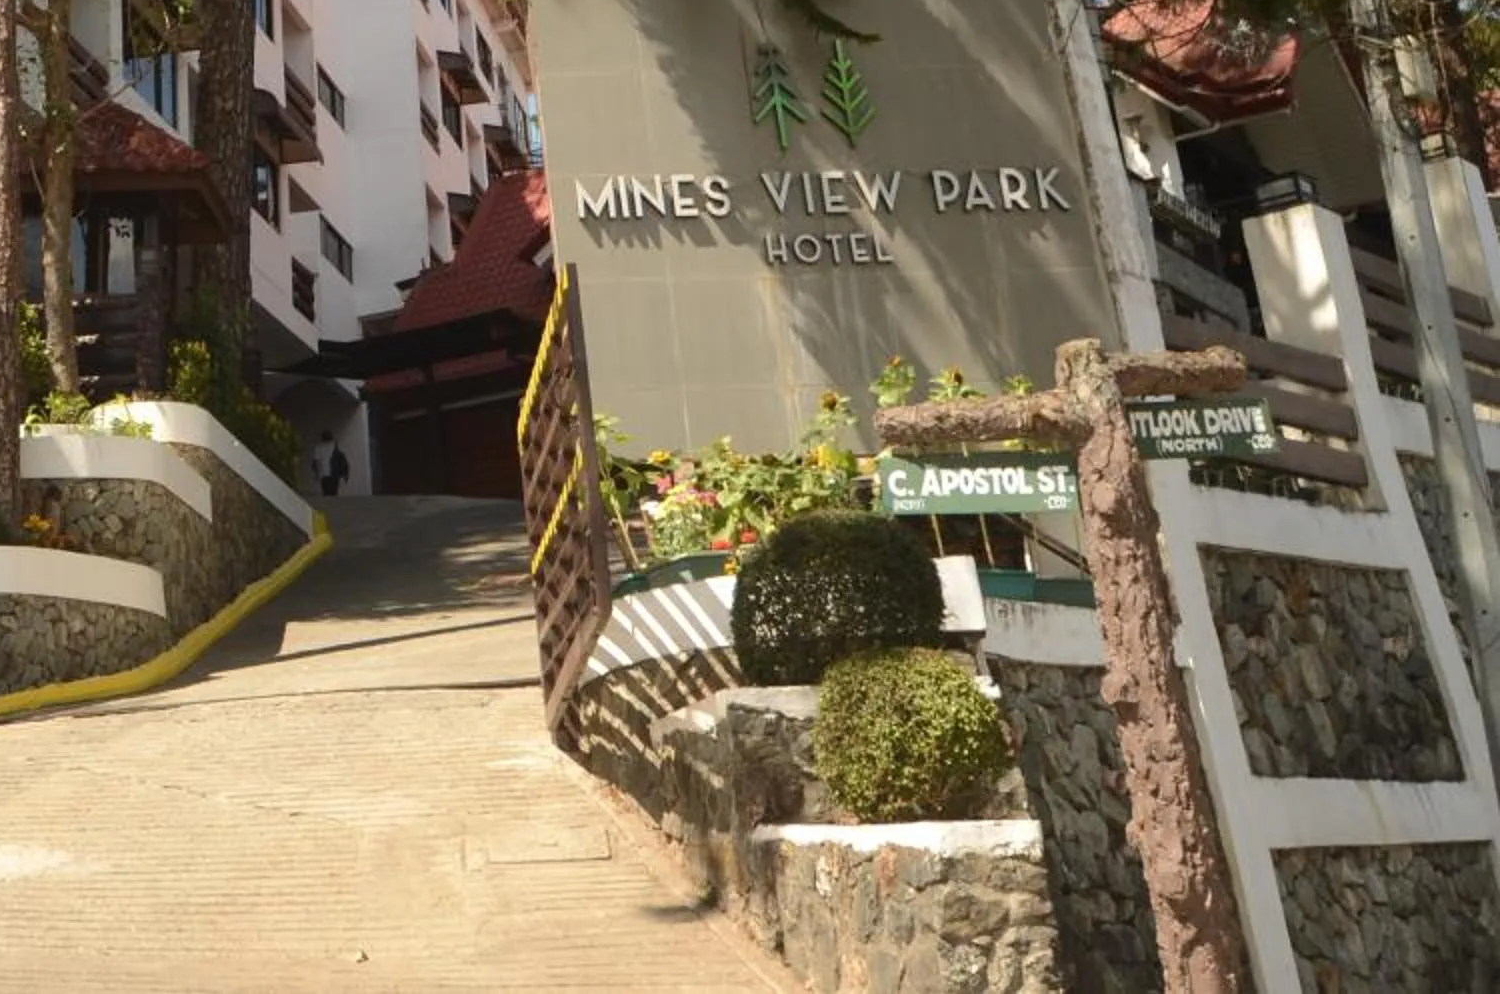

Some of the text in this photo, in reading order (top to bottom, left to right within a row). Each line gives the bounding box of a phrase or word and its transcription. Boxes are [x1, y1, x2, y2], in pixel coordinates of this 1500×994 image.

[575, 167, 1071, 222] MINES VIEW PARK
[764, 231, 894, 266] HOTEL
[1203, 405, 1267, 434] DRIVE
[1155, 435, 1224, 457] (NORTH)
[887, 464, 1076, 497] C. APOSTOL ST.
